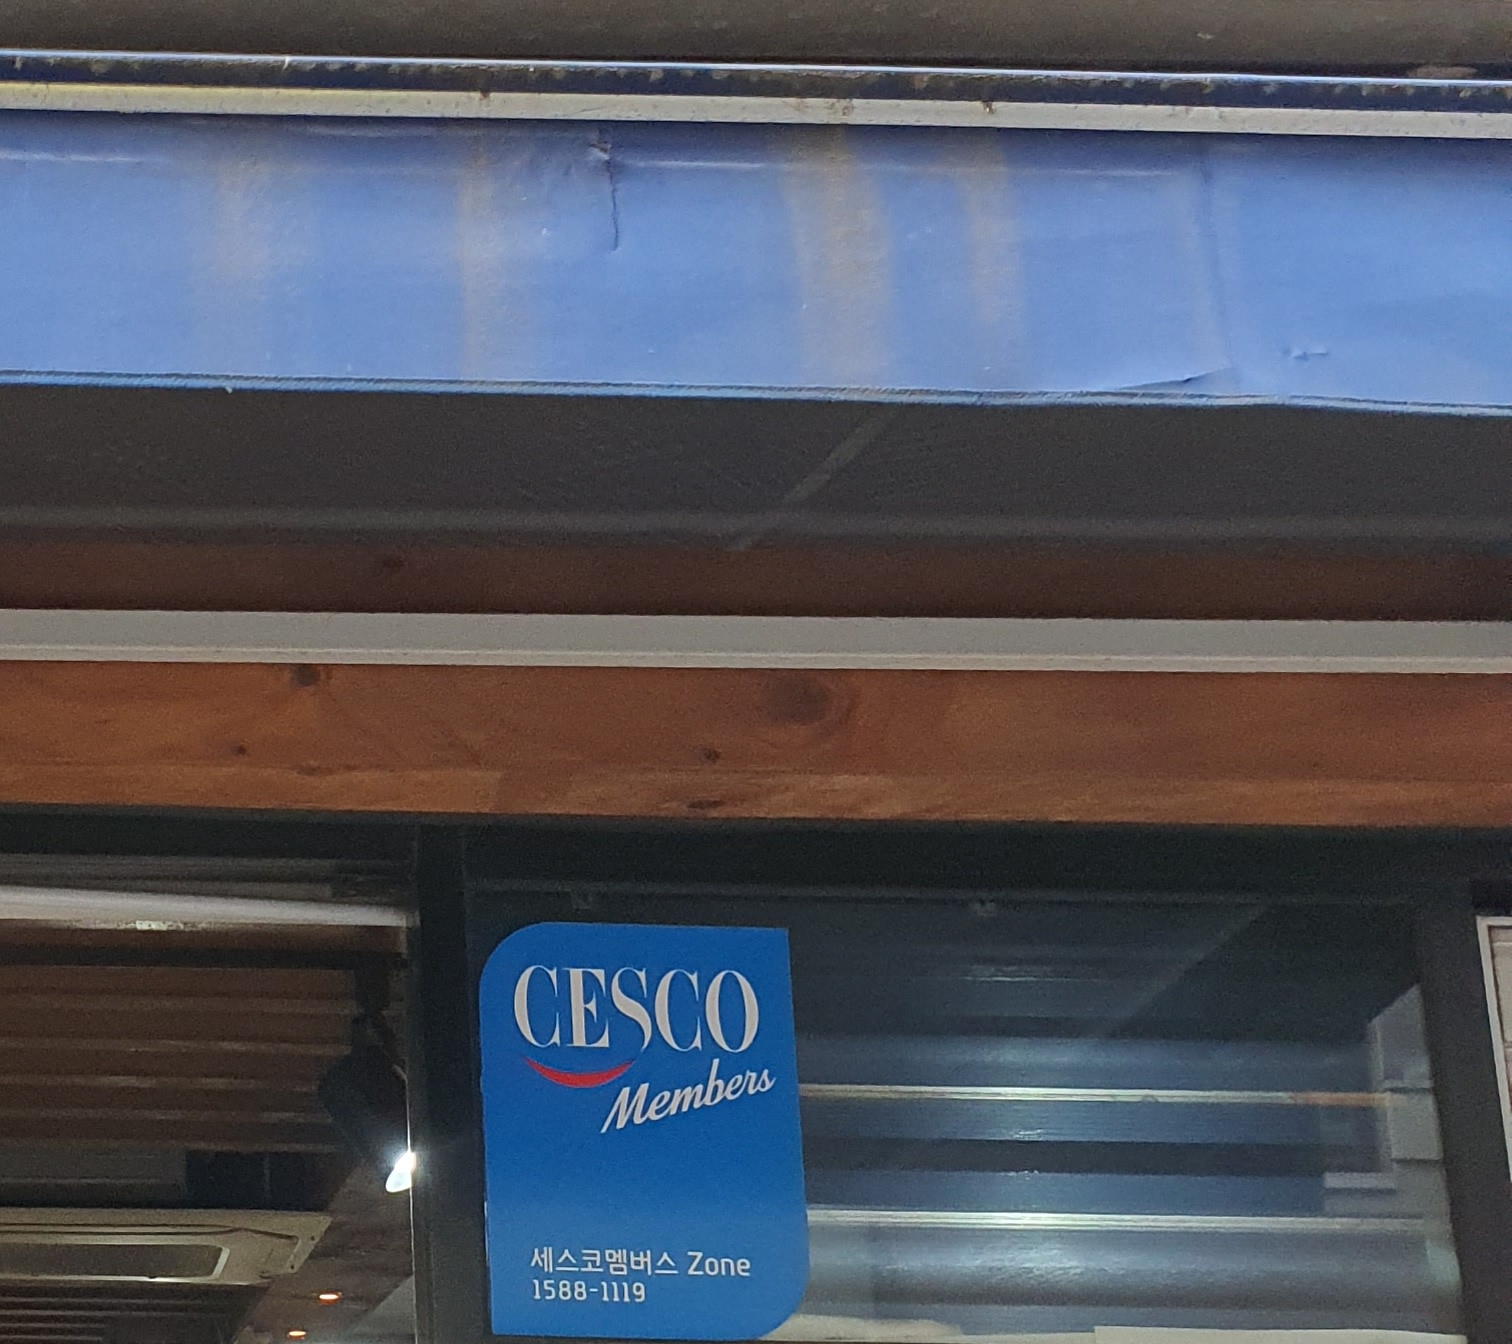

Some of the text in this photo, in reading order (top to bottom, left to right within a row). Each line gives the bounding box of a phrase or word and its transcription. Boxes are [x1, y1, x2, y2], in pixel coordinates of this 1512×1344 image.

[514, 964, 760, 1053] CESCO
[600, 1058, 777, 1133] Members
[530, 1246, 751, 1277] 세스코멤버스 Zone
[532, 1280, 646, 1303] 1588-1119
